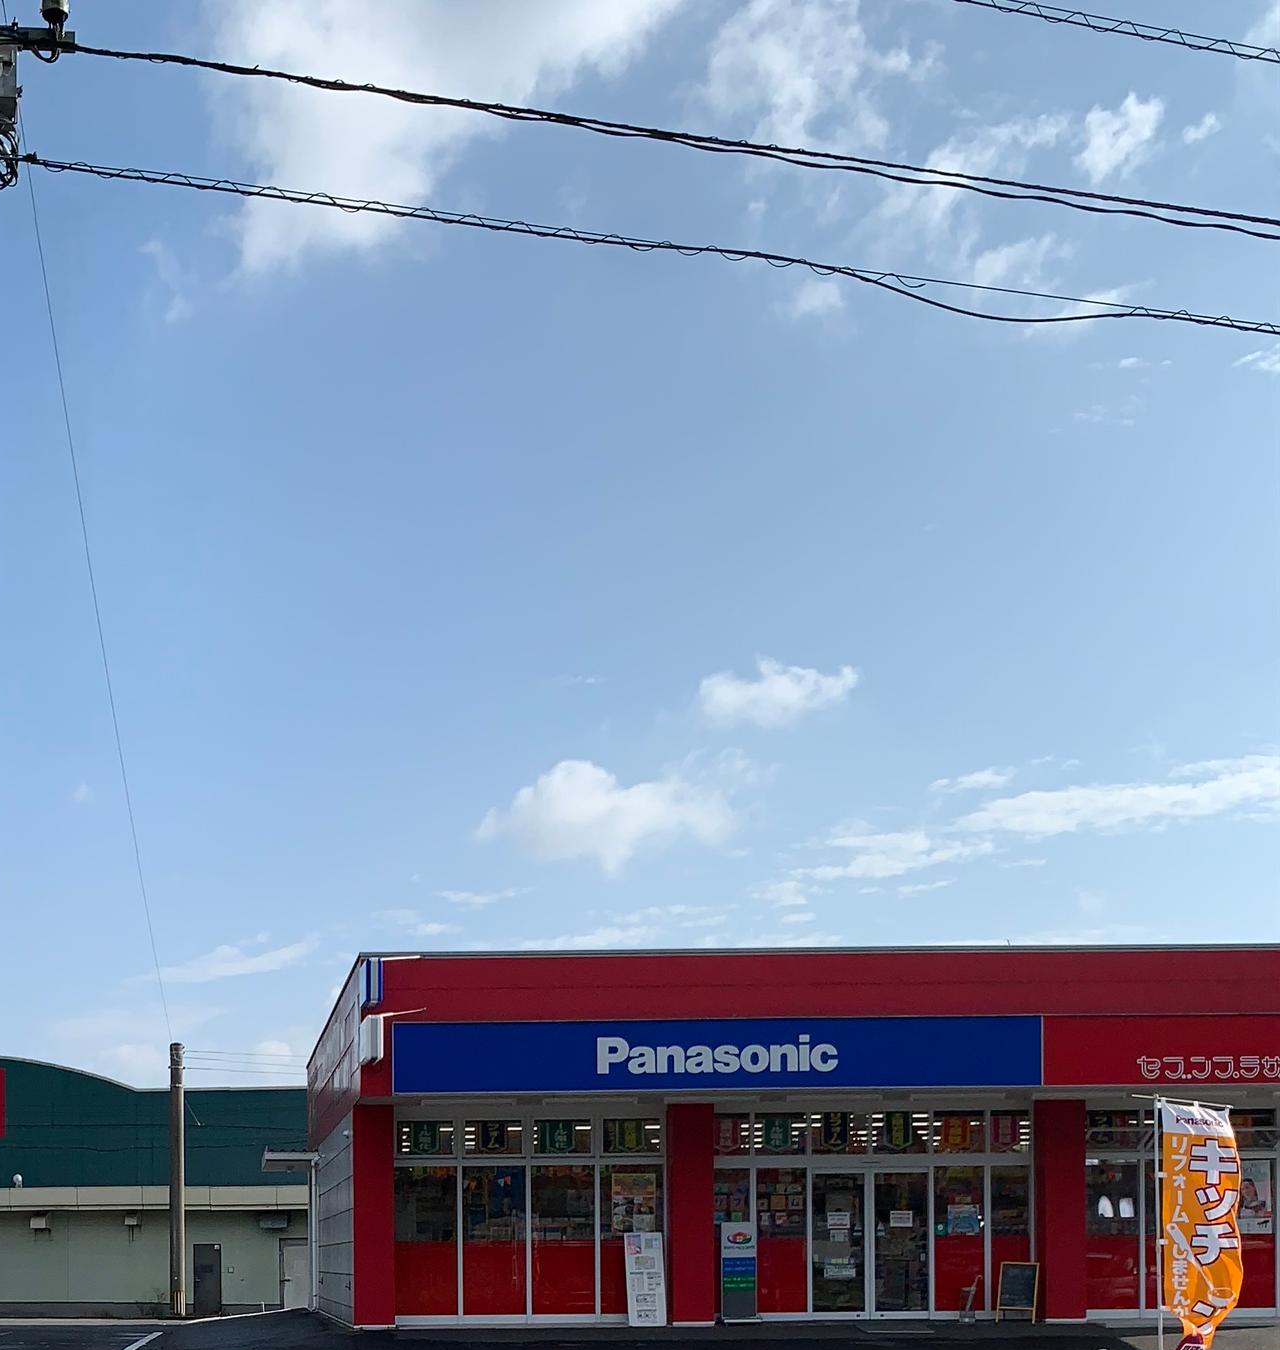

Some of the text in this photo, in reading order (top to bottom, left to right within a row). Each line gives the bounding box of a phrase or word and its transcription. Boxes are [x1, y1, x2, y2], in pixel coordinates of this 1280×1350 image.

[596, 1034, 839, 1075] Panasonic
[1175, 1114, 1224, 1128] Panasonic
[1188, 1138, 1240, 1336] キッチン
